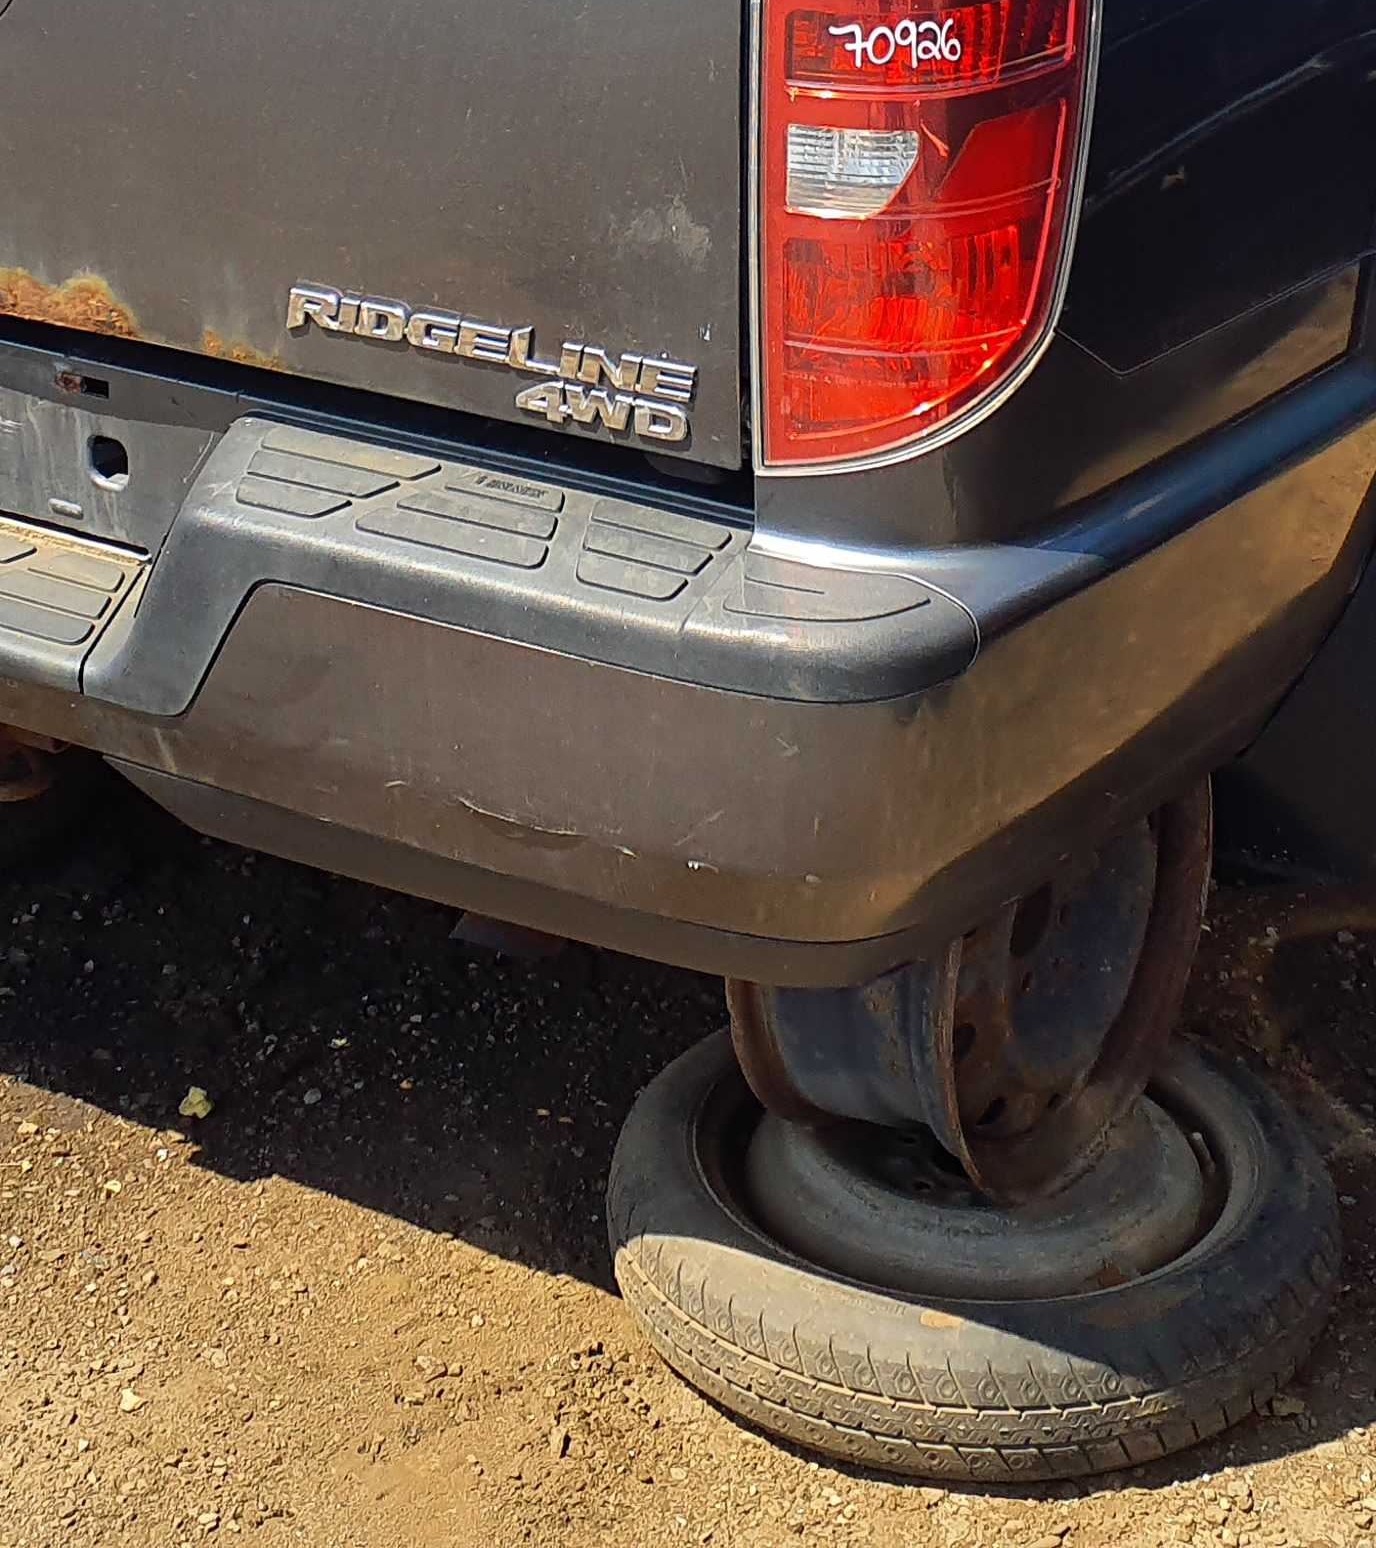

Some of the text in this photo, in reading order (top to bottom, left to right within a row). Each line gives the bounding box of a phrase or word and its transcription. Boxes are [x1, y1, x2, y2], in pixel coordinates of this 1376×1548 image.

[827, 17, 962, 69] 70926
[286, 279, 699, 404] RIDGELINE
[515, 379, 690, 442] 4WD
